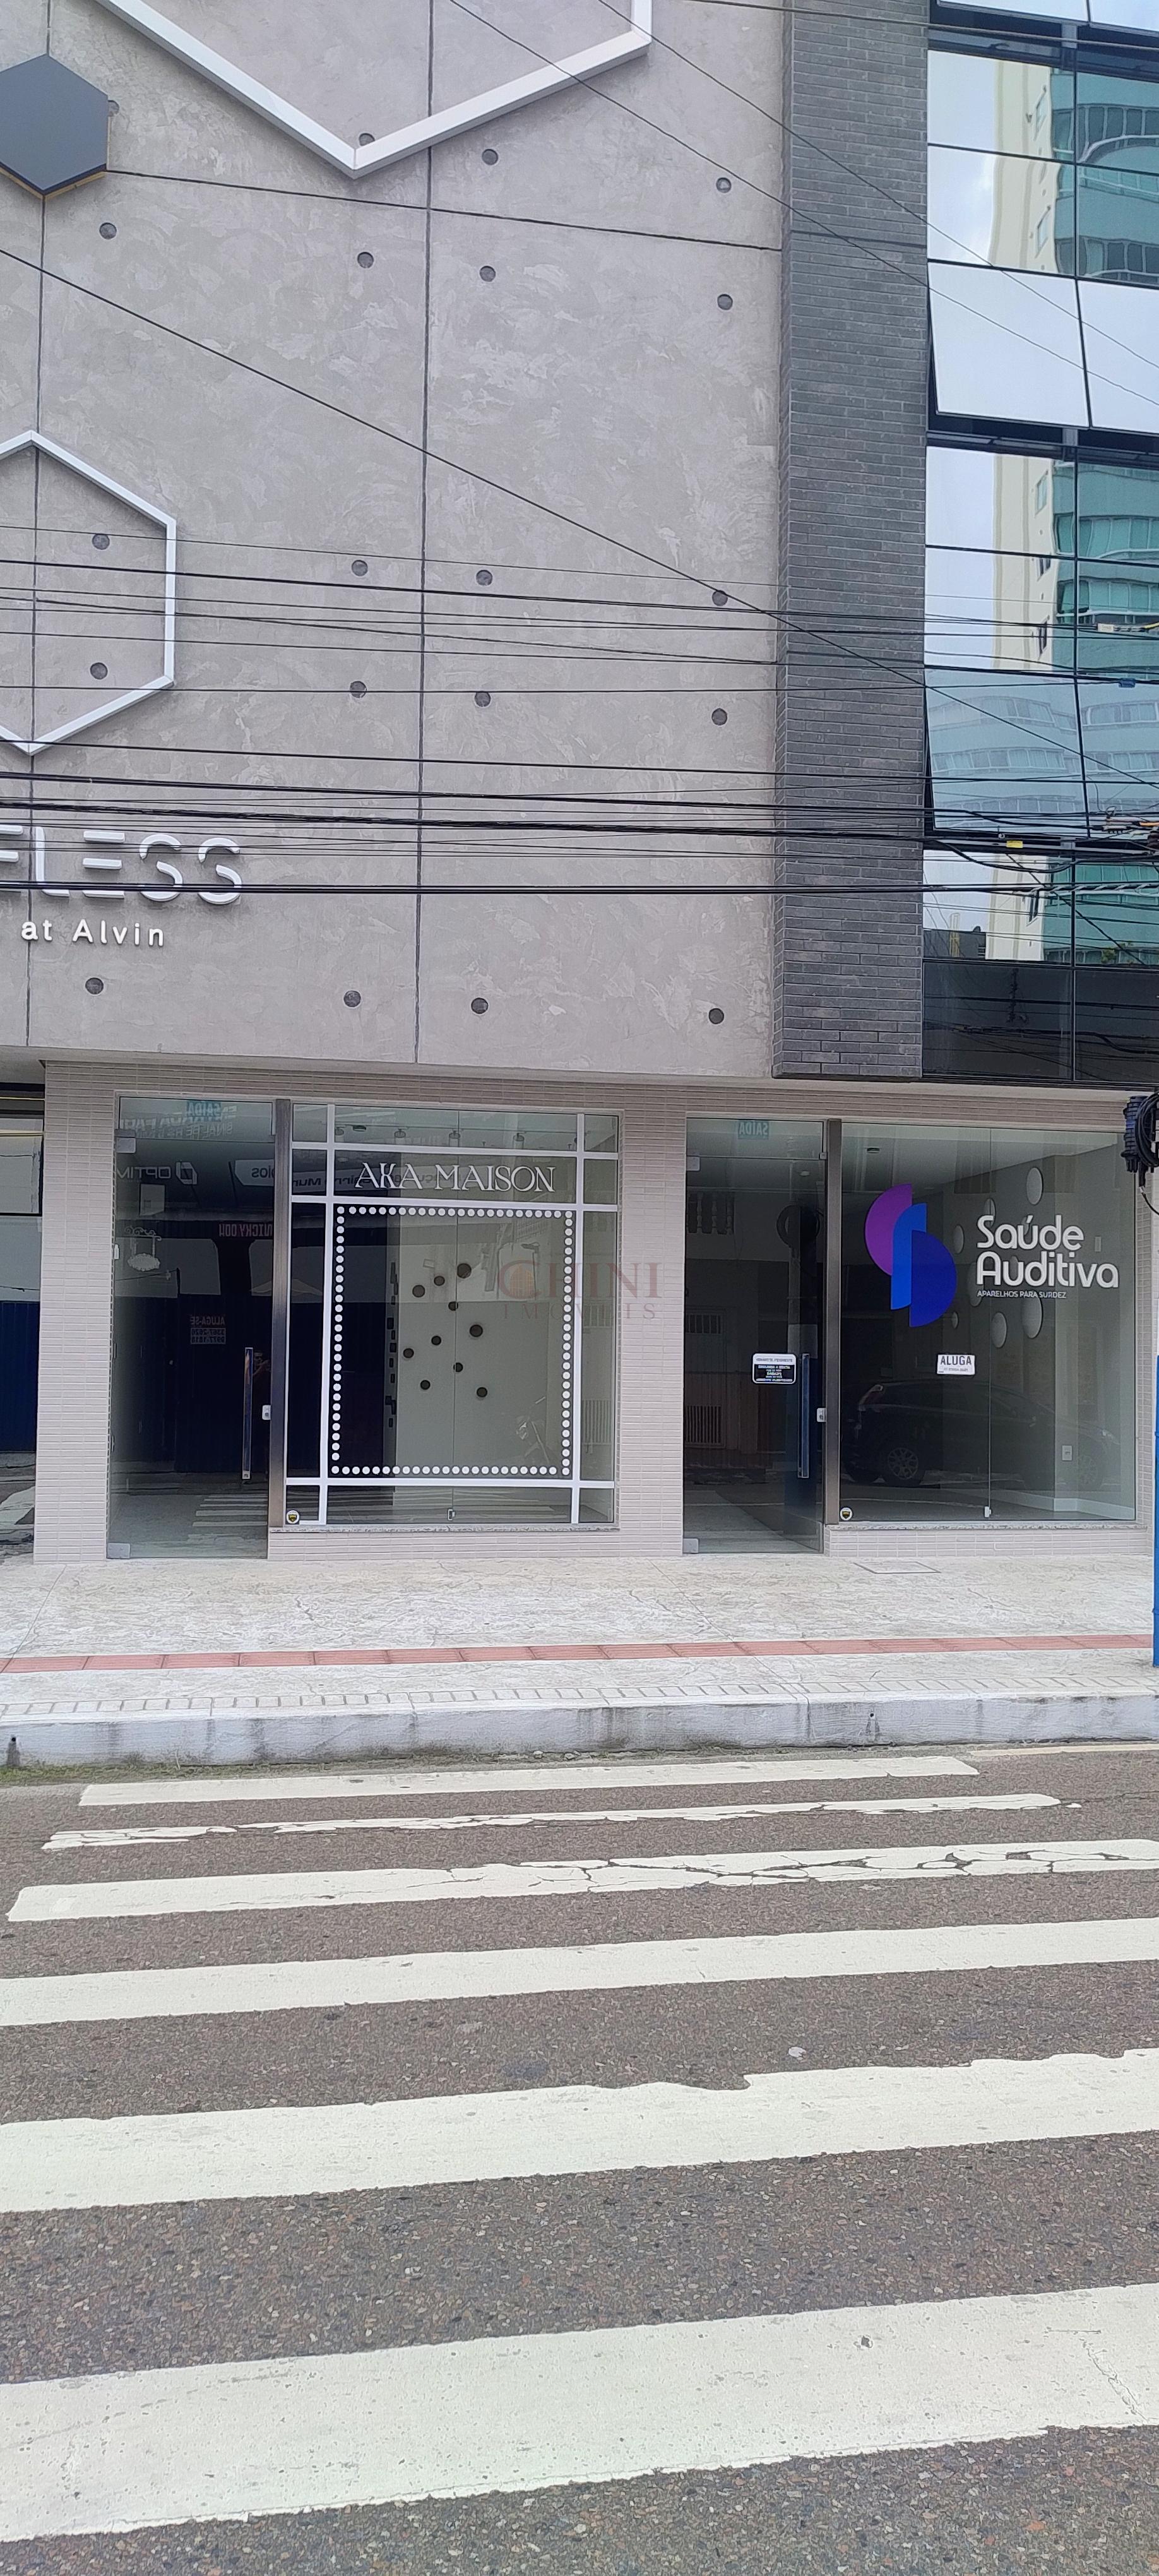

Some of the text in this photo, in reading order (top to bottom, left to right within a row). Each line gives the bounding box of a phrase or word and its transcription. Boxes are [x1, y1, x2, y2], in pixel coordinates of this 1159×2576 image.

[21, 919, 163, 946] at Alvin
[355, 1162, 422, 1190] AKA
[434, 1164, 556, 1192] MAISON
[977, 1215, 1084, 1250] Saúde
[977, 1251, 1119, 1288] Auditiva
[977, 1290, 1018, 1298] APARELHOS
[1020, 1291, 1037, 1299] PARA
[940, 1356, 972, 1365] ALUGA
